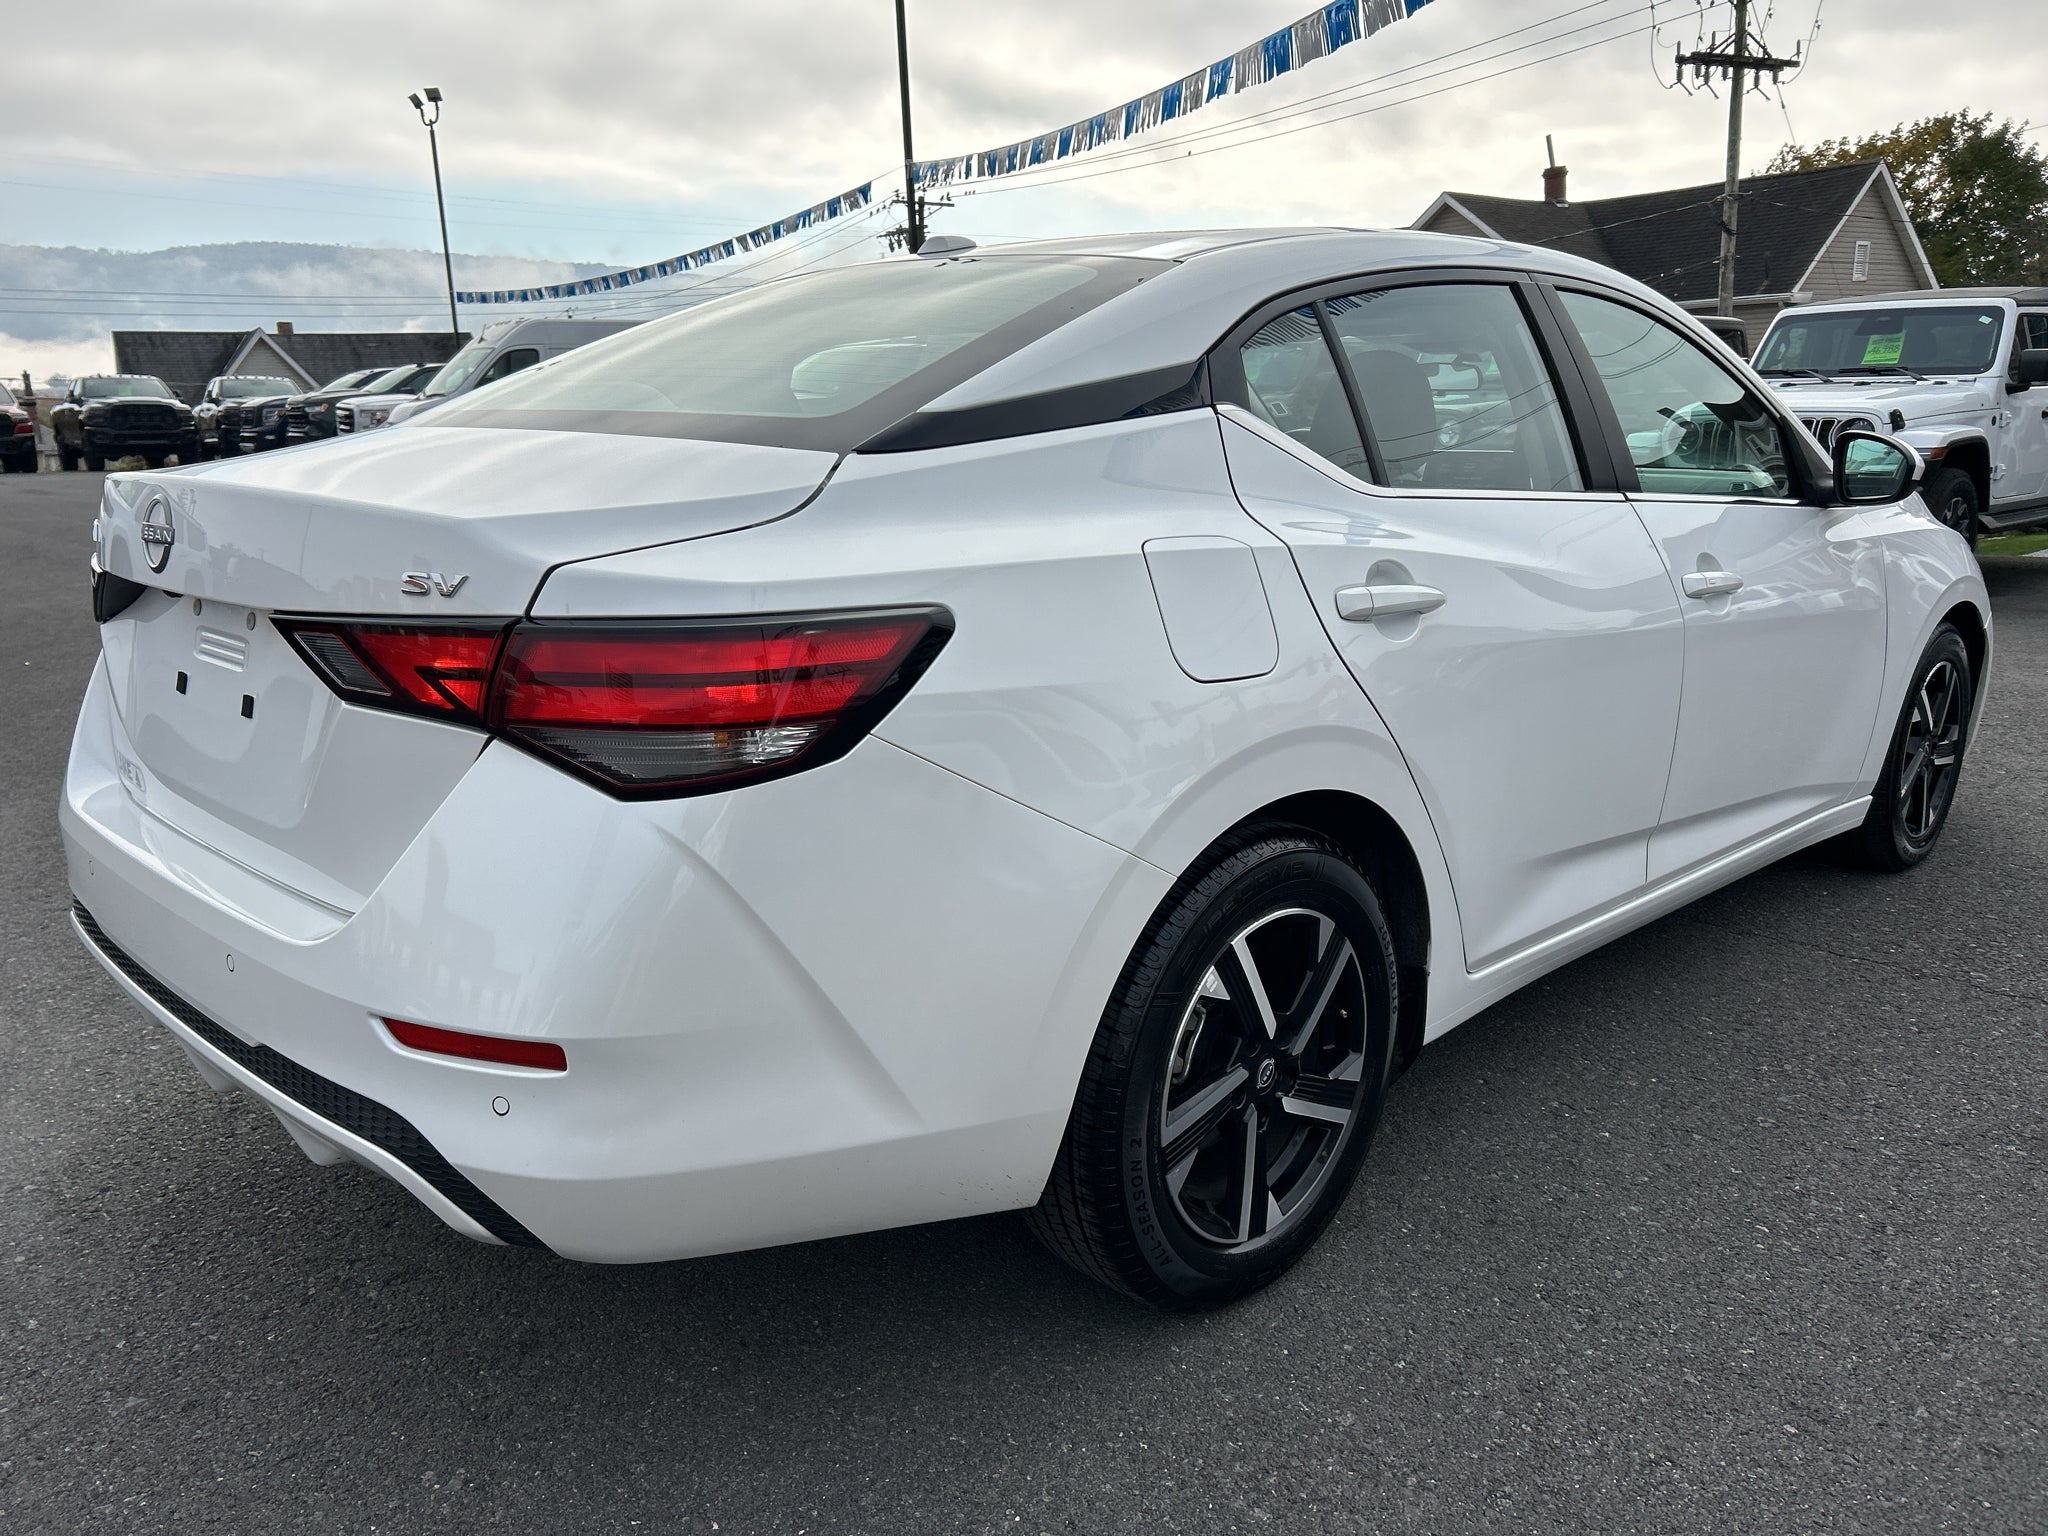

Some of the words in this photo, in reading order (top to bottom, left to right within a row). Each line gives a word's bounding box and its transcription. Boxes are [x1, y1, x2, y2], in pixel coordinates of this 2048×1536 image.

[143, 526, 172, 542] SSAN
[400, 571, 469, 598] SV
[1130, 1137, 1142, 1148] 2
[1130, 1160, 1174, 1267] ALL-SEASON
